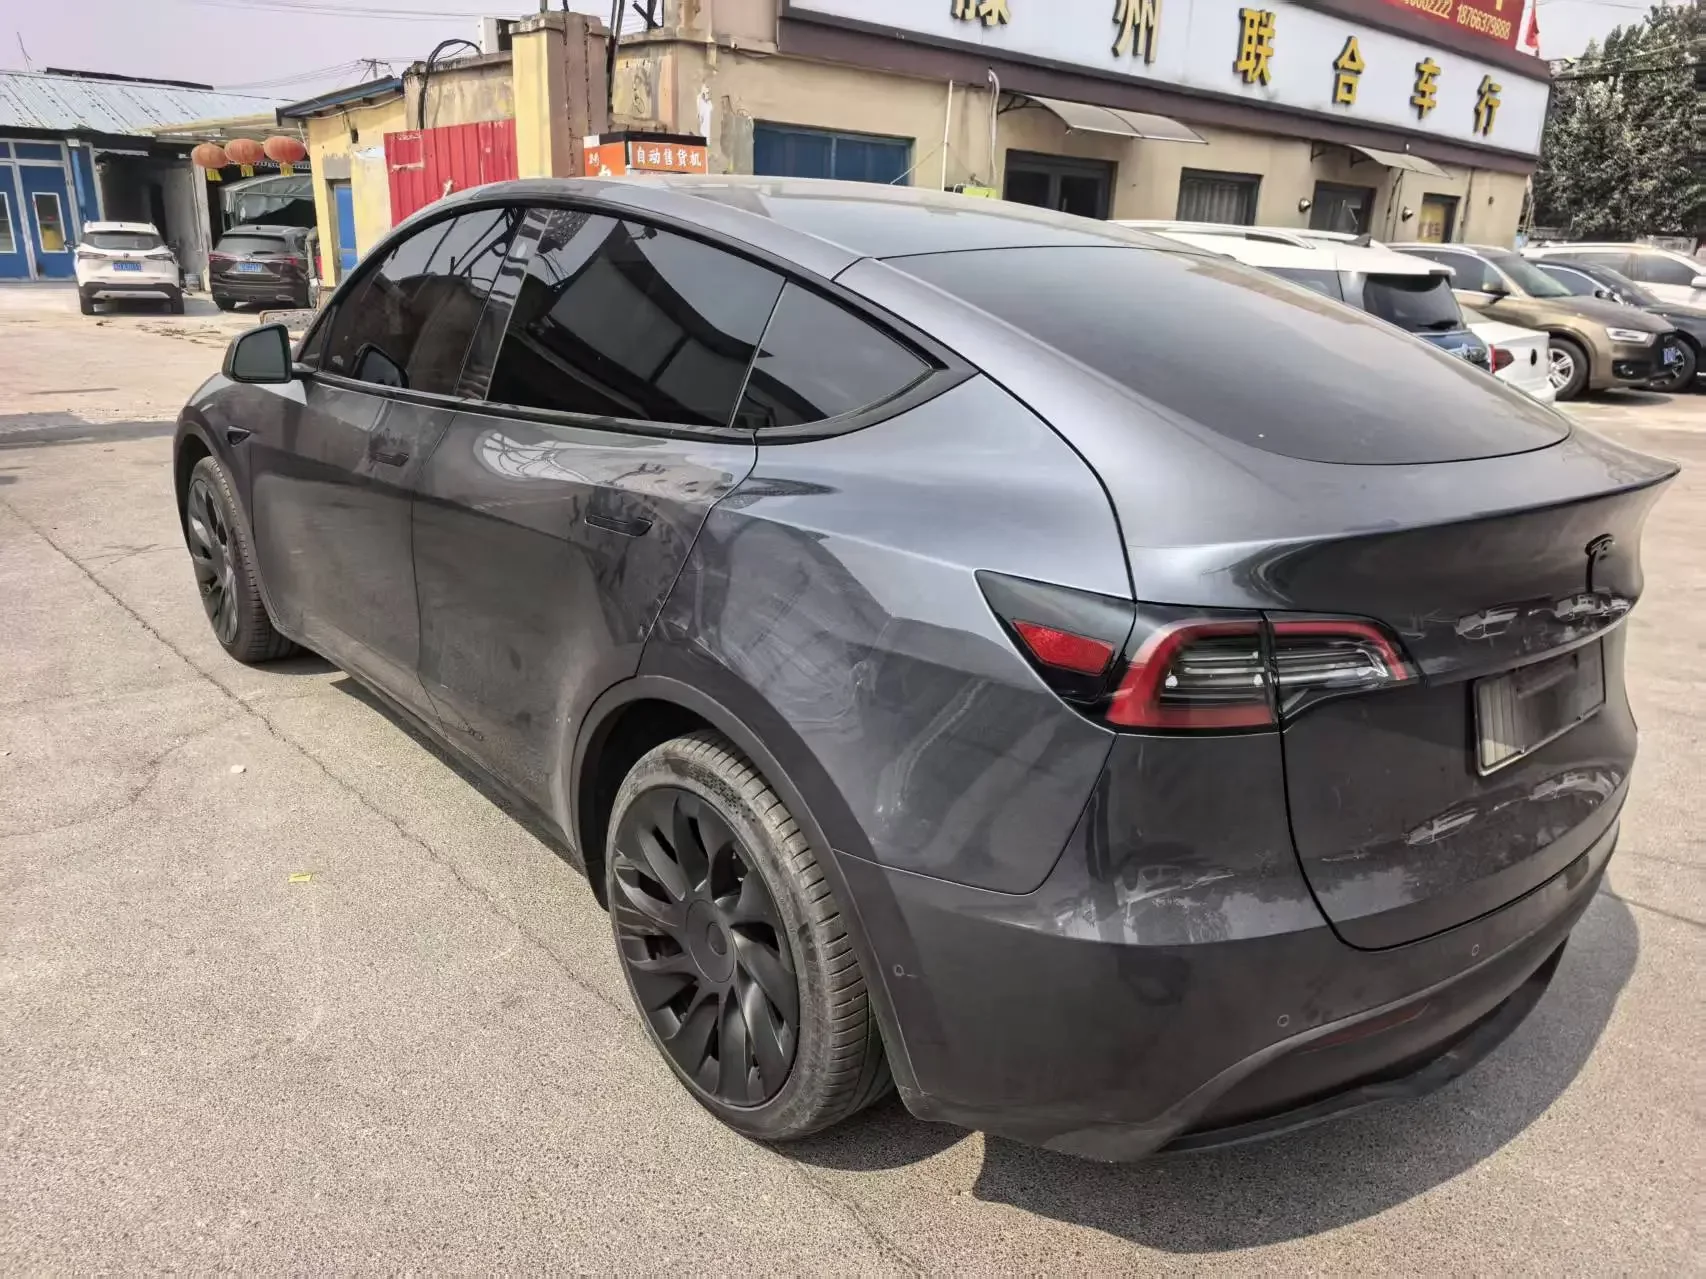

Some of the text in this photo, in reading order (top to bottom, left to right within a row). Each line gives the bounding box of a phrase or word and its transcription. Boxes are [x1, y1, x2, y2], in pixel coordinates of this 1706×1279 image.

[950, 0, 1502, 137] 州联合车行
[637, 146, 702, 167] 自动售货机
